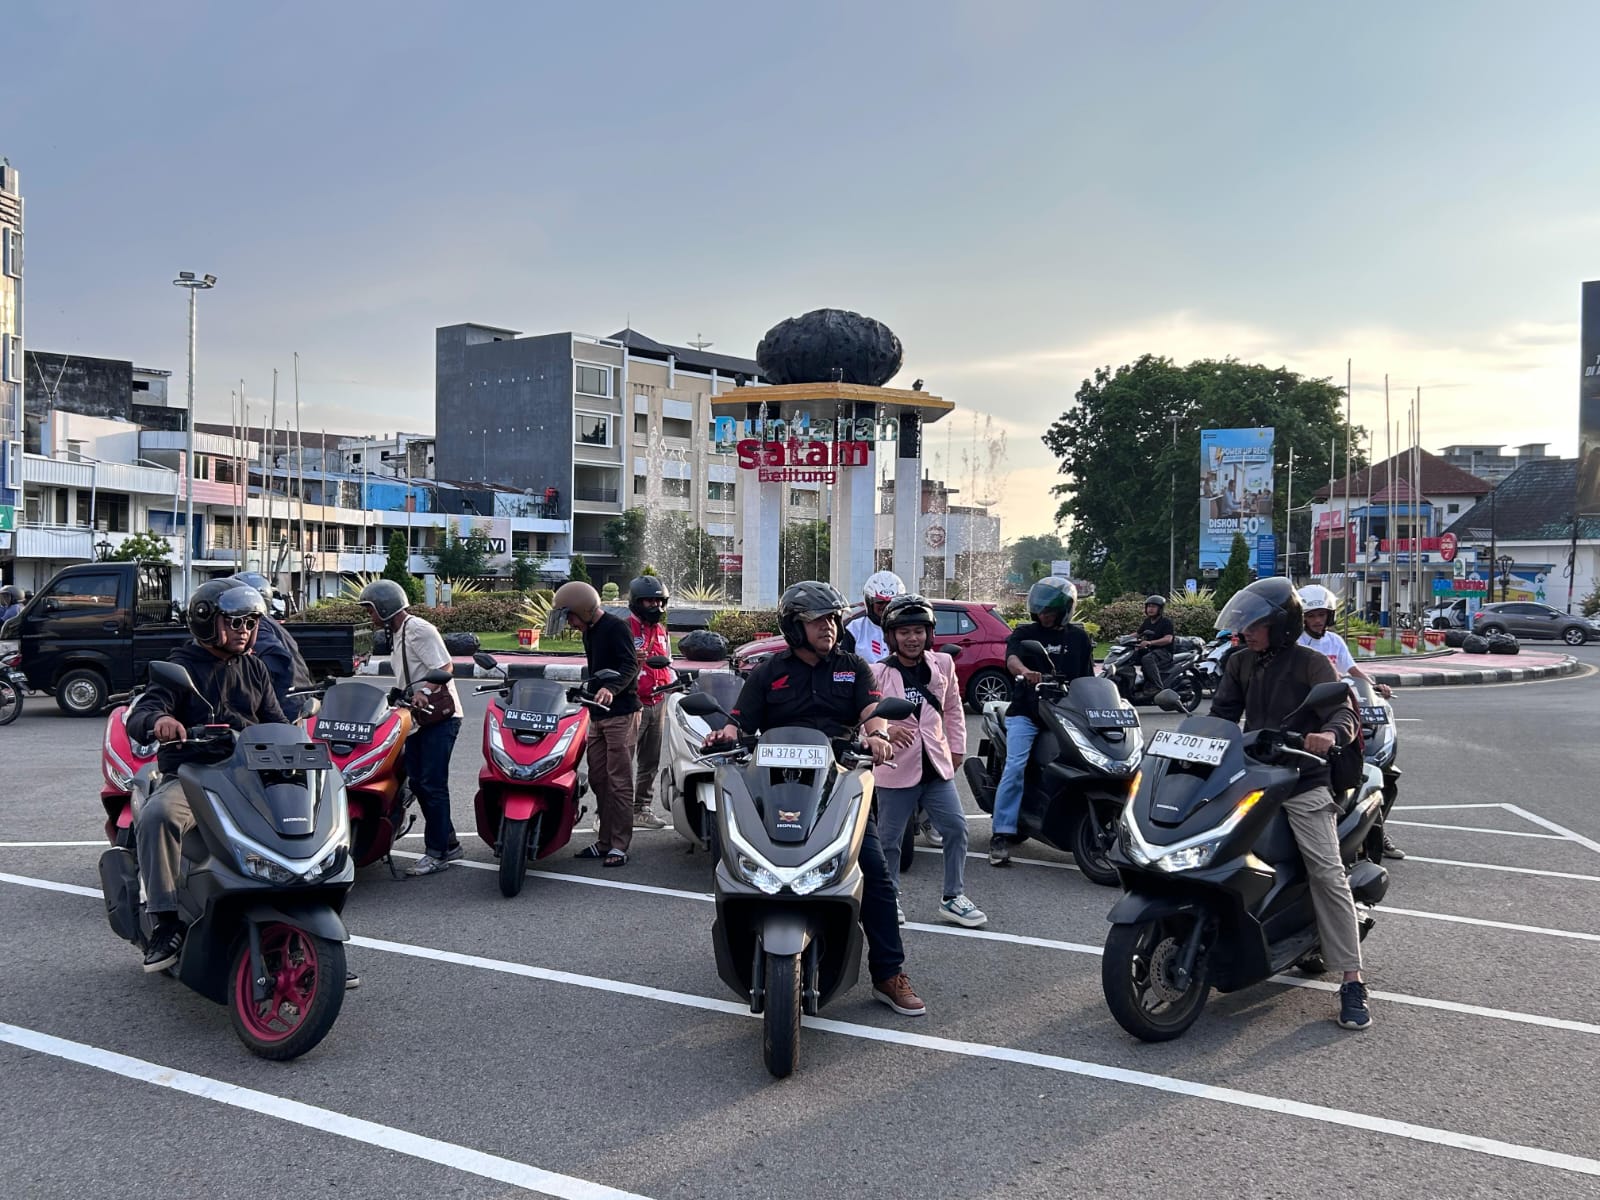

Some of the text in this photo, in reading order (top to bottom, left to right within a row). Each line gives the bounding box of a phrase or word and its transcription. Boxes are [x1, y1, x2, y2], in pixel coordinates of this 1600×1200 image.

[737, 436, 869, 470] Satam
[758, 467, 837, 484] Belitung
[1208, 518, 1238, 528] DISKON
[506, 710, 518, 720] BN
[520, 712, 542, 722] 6520
[1088, 710, 1100, 718] BN
[318, 720, 332, 730] BN
[333, 721, 357, 732] 5663
[1155, 732, 1172, 744] BN
[1174, 735, 1204, 749] 2001
[761, 747, 774, 758] BN
[776, 748, 803, 759] 3787
